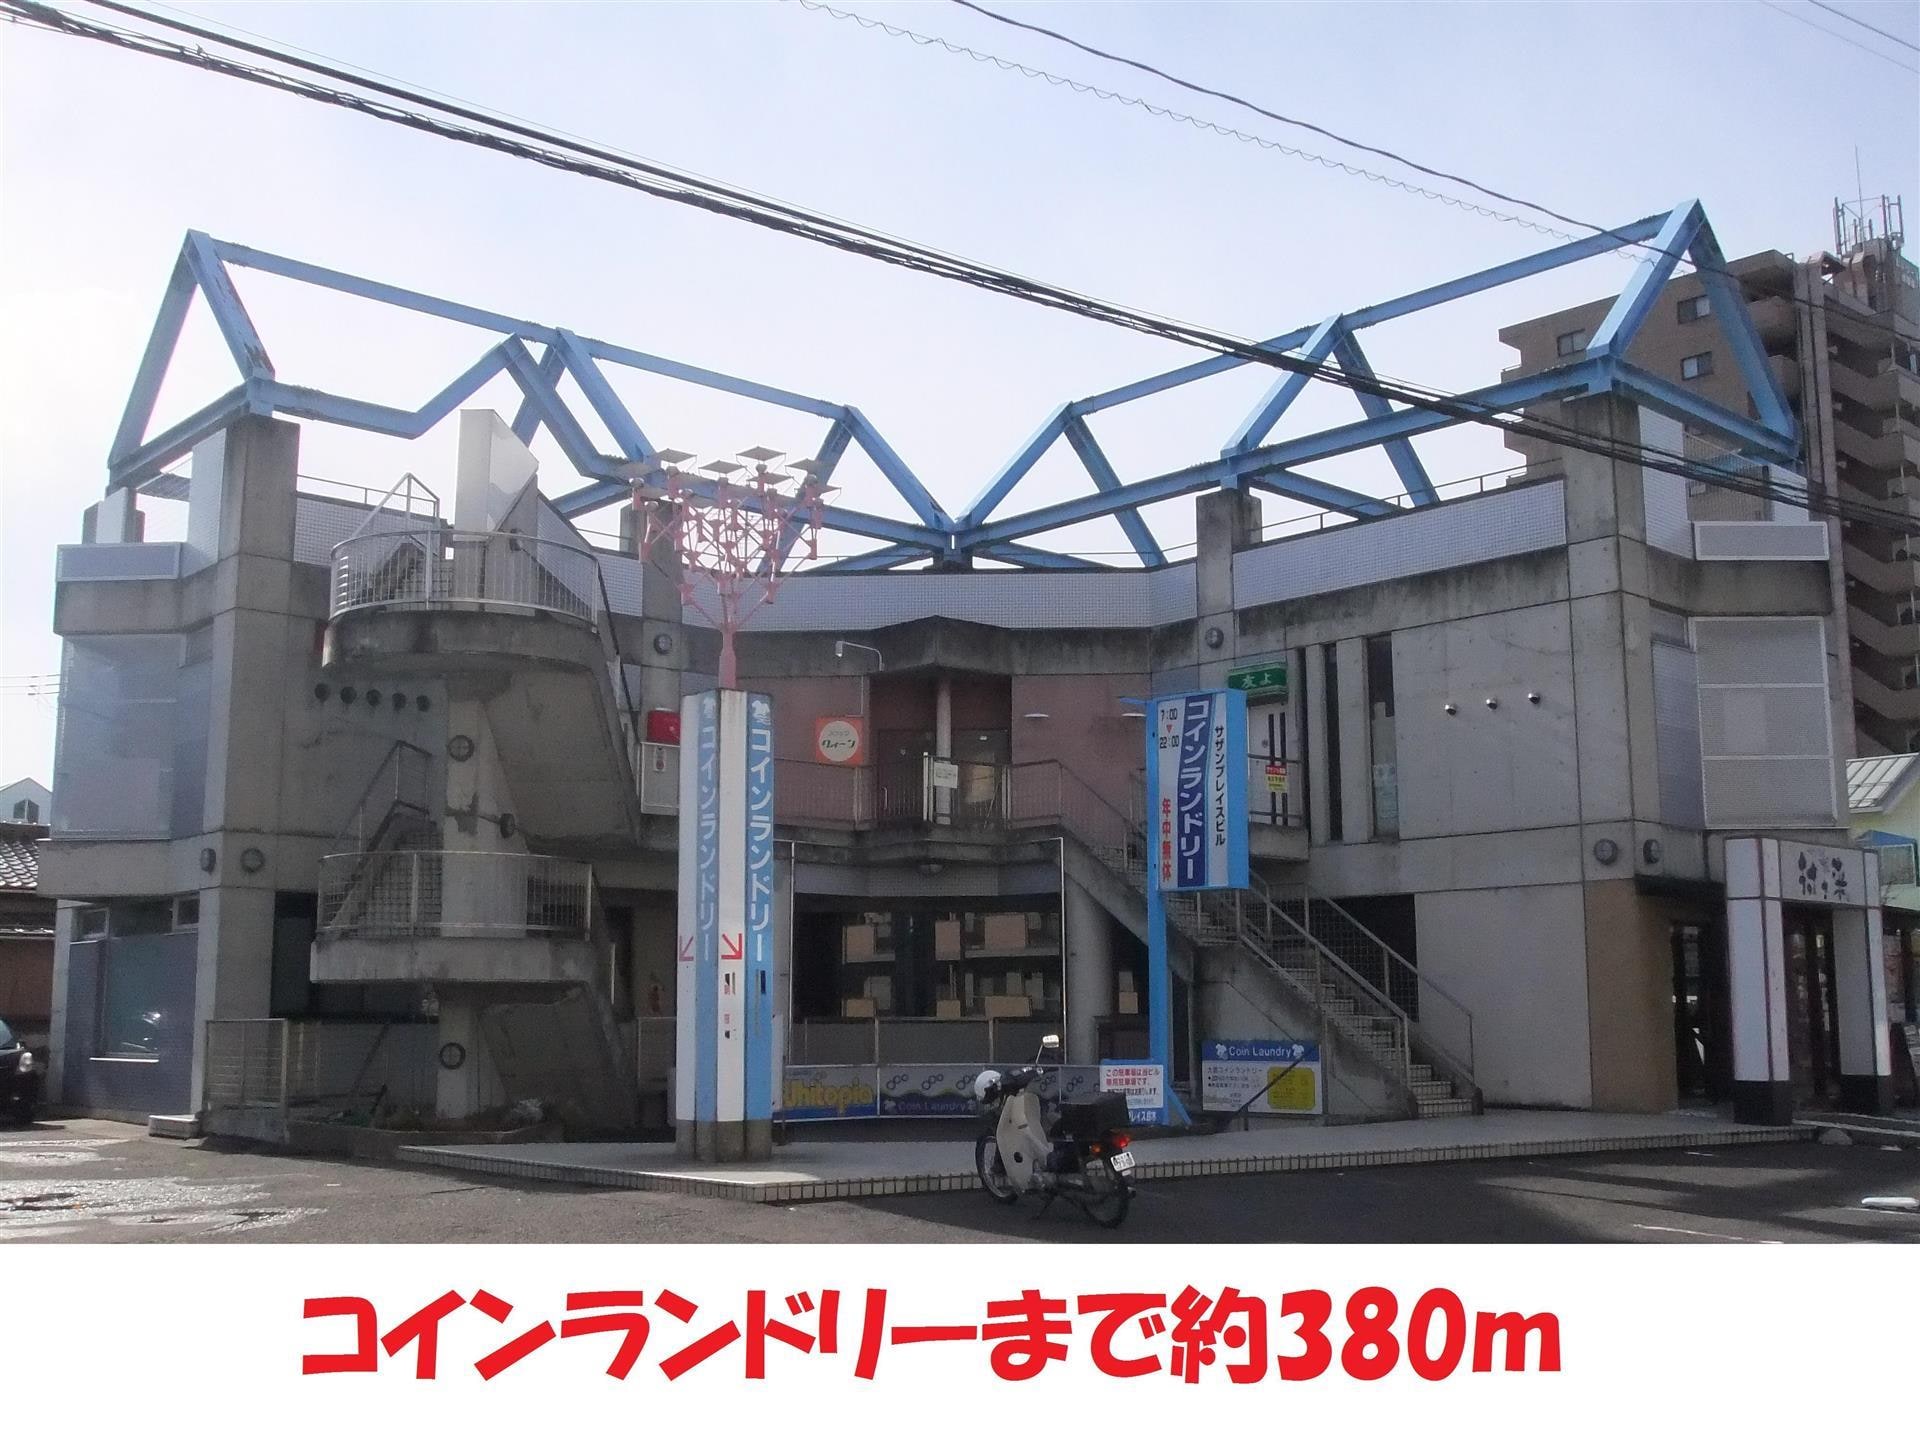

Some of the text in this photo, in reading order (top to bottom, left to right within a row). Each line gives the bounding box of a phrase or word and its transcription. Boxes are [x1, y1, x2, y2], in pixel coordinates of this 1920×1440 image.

[1159, 735, 1180, 749] 22:00
[1160, 708, 1178, 721] 7:00
[1180, 701, 1209, 879] コインランドリー
[1214, 725, 1226, 846] サザンプレイスビル
[700, 727, 717, 961] コインランドリー
[750, 728, 771, 962] コインランドリー
[1161, 797, 1172, 881] 年中無休
[1228, 1046, 1292, 1058] Coin Laundry
[898, 1101, 966, 1112] Coin Laundry
